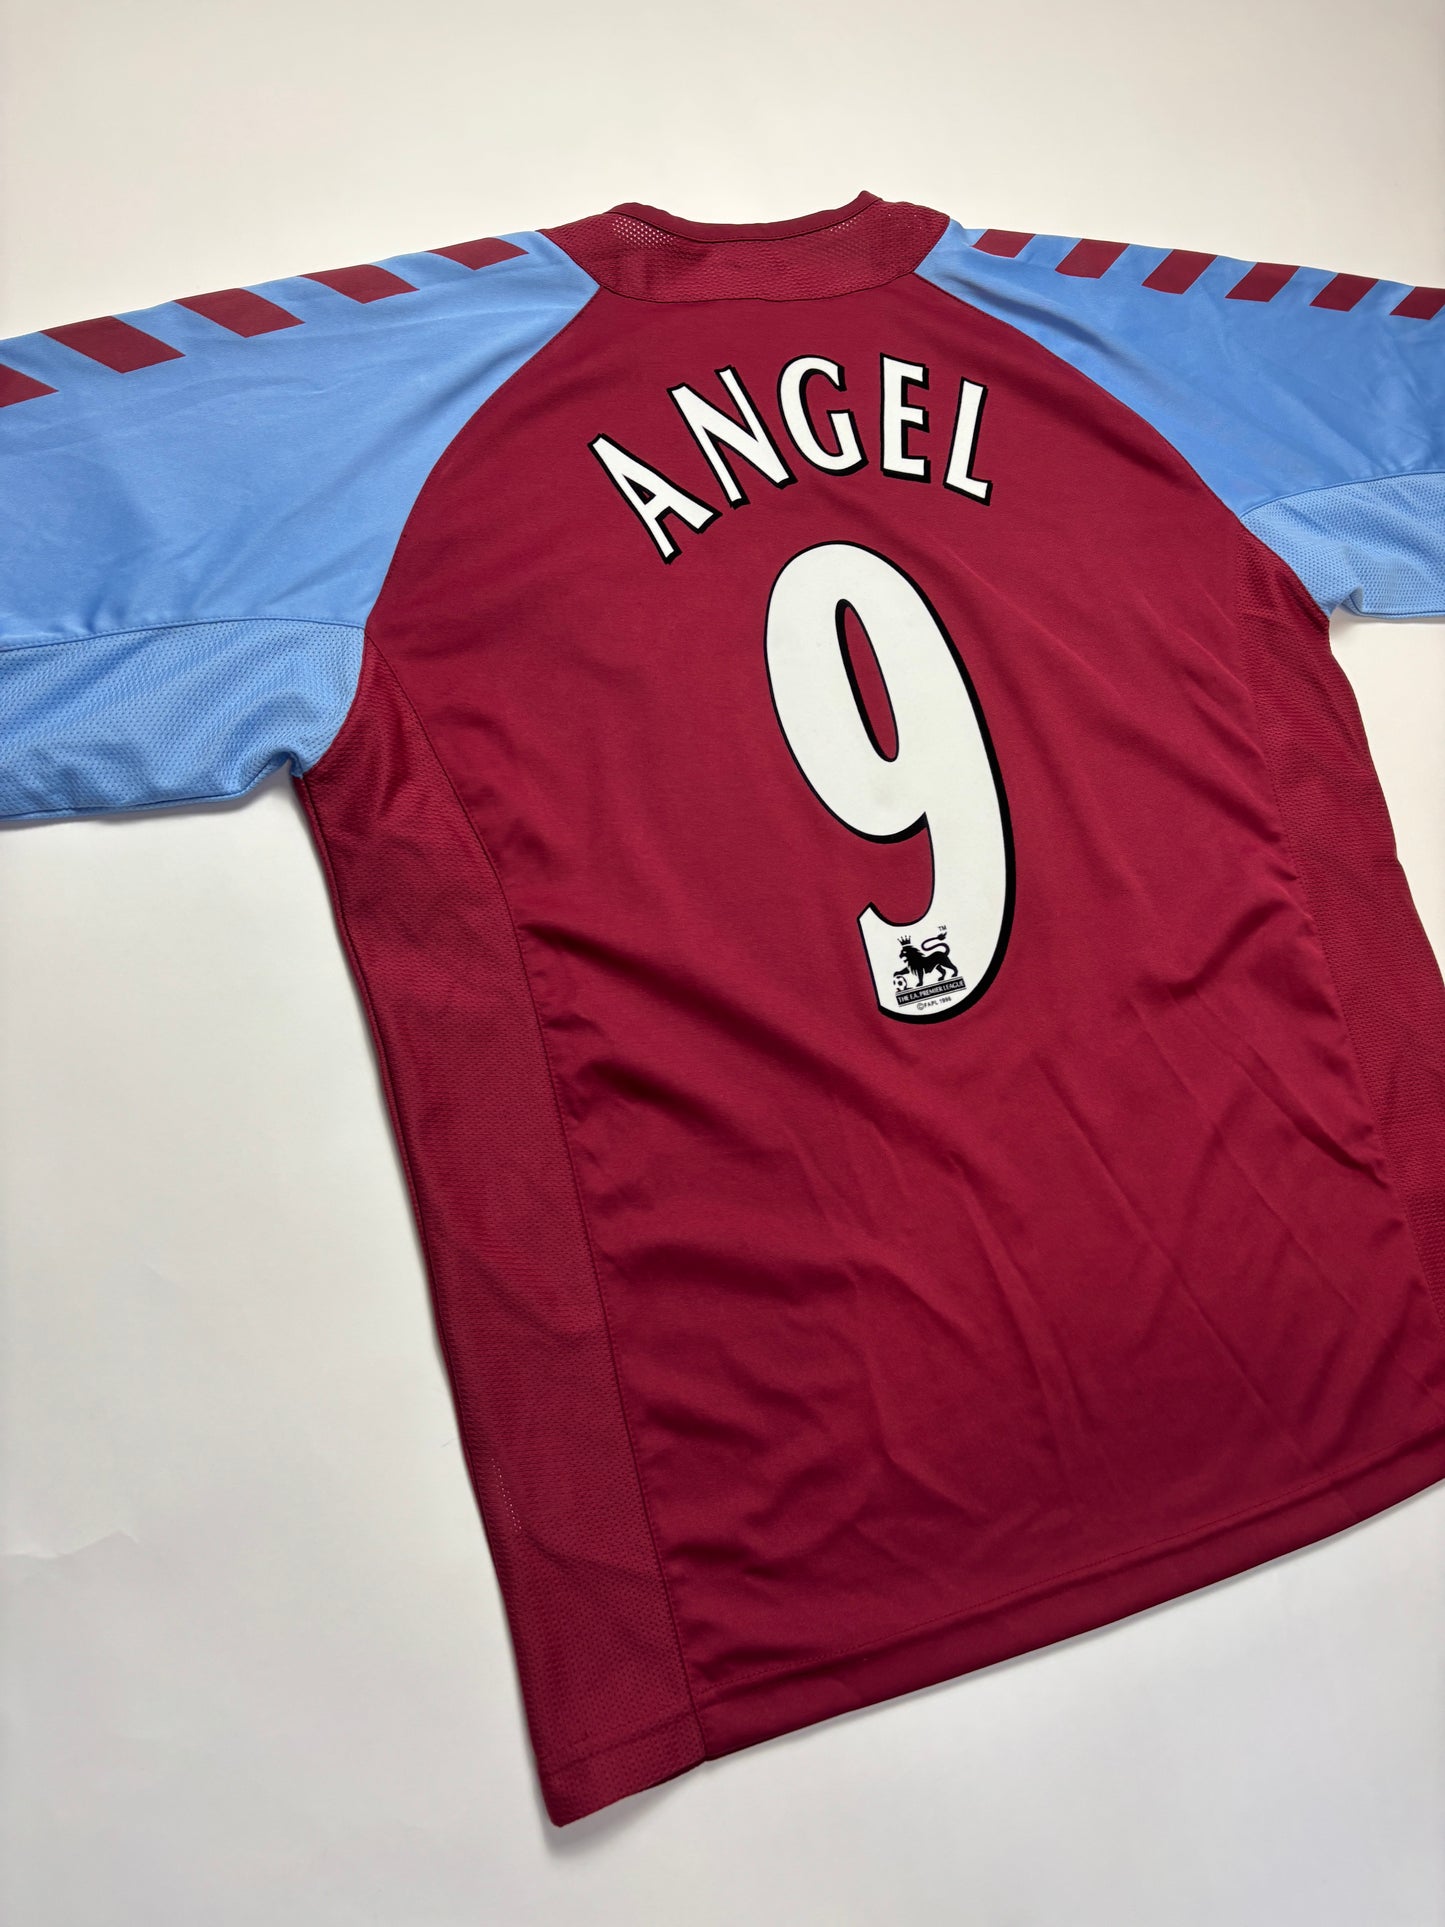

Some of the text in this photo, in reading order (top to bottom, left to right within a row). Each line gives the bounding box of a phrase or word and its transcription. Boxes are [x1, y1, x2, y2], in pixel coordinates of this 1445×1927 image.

[587, 353, 994, 566] ANGEL
[764, 540, 1017, 1024] 9
[919, 986, 943, 997] PREMIER
[943, 980, 965, 991] LEAGUE
